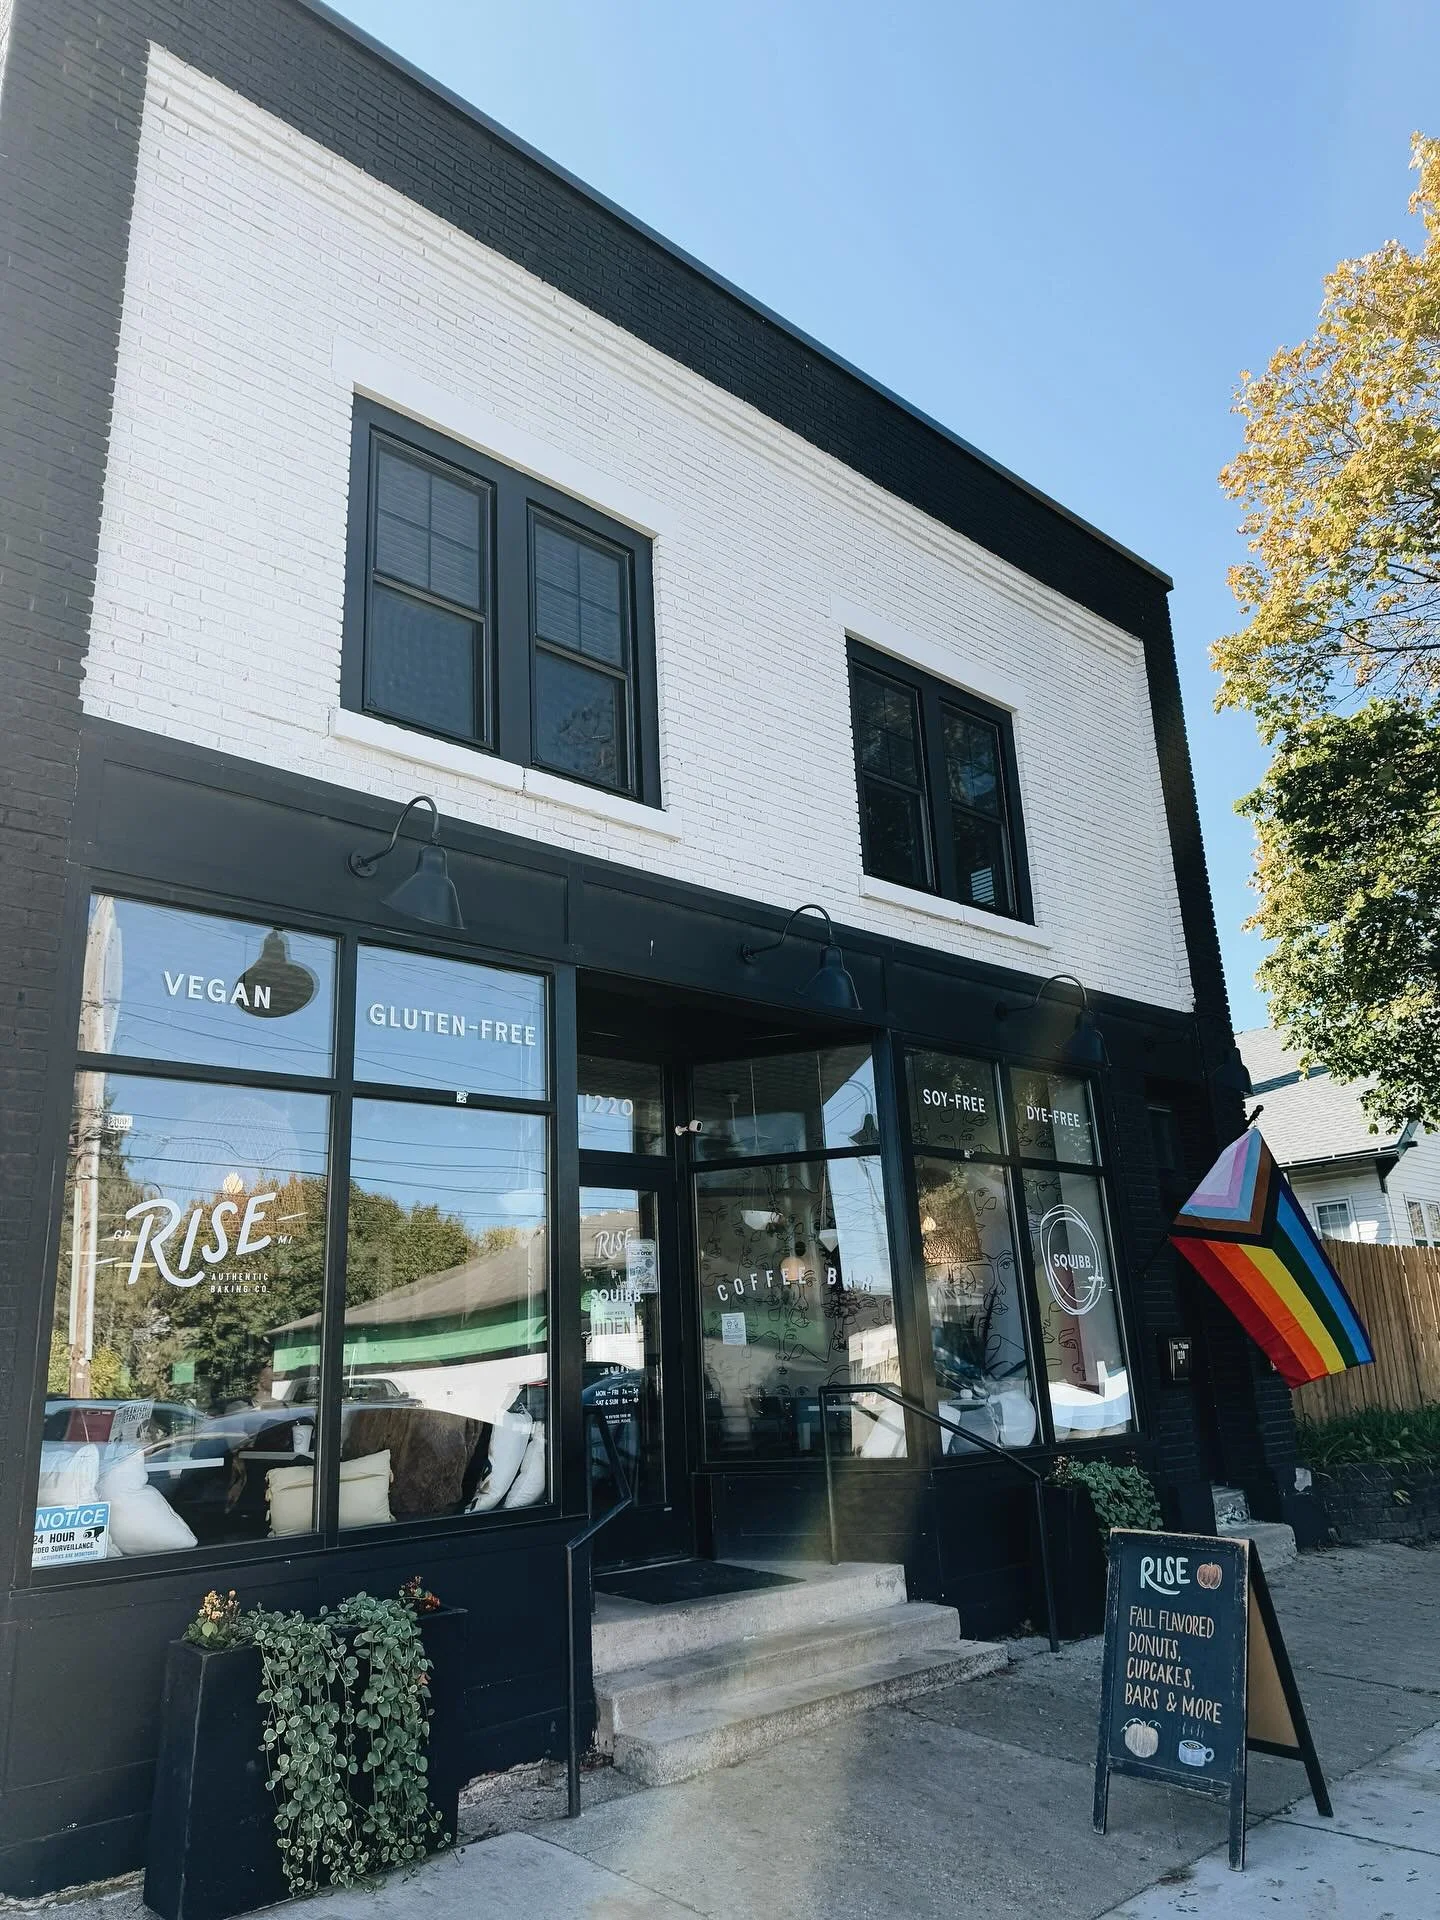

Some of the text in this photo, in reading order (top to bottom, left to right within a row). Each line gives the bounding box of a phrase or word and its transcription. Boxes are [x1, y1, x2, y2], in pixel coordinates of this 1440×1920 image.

[164, 970, 271, 1009] VEGAN
[369, 1003, 536, 1046] GLUTEN-FREE
[585, 1094, 633, 1117] 1220
[923, 1088, 986, 1113] SOY-FREE
[1026, 1105, 1080, 1128] DYE-FREE
[113, 1229, 131, 1241] GR
[125, 1192, 277, 1288] RISE
[277, 1235, 293, 1245] MI
[595, 1228, 634, 1259] RISE
[1053, 1253, 1094, 1271] SQUIBB.
[211, 1272, 269, 1281] AUTHENTIC
[717, 1267, 807, 1301] COFFEE
[210, 1285, 270, 1294] BAKING CO.
[35, 1508, 106, 1529] NOTICE
[33, 1531, 75, 1545] 24 HOUR
[51, 1542, 94, 1553] SURVEILLANCE
[1140, 1556, 1191, 1595] RISE
[1129, 1605, 1215, 1639] FALL FLAVORED
[1128, 1631, 1181, 1662] DONUTS,
[1126, 1656, 1195, 1691] CUPCAKES,
[1124, 1682, 1223, 1724] BARS & MORE
